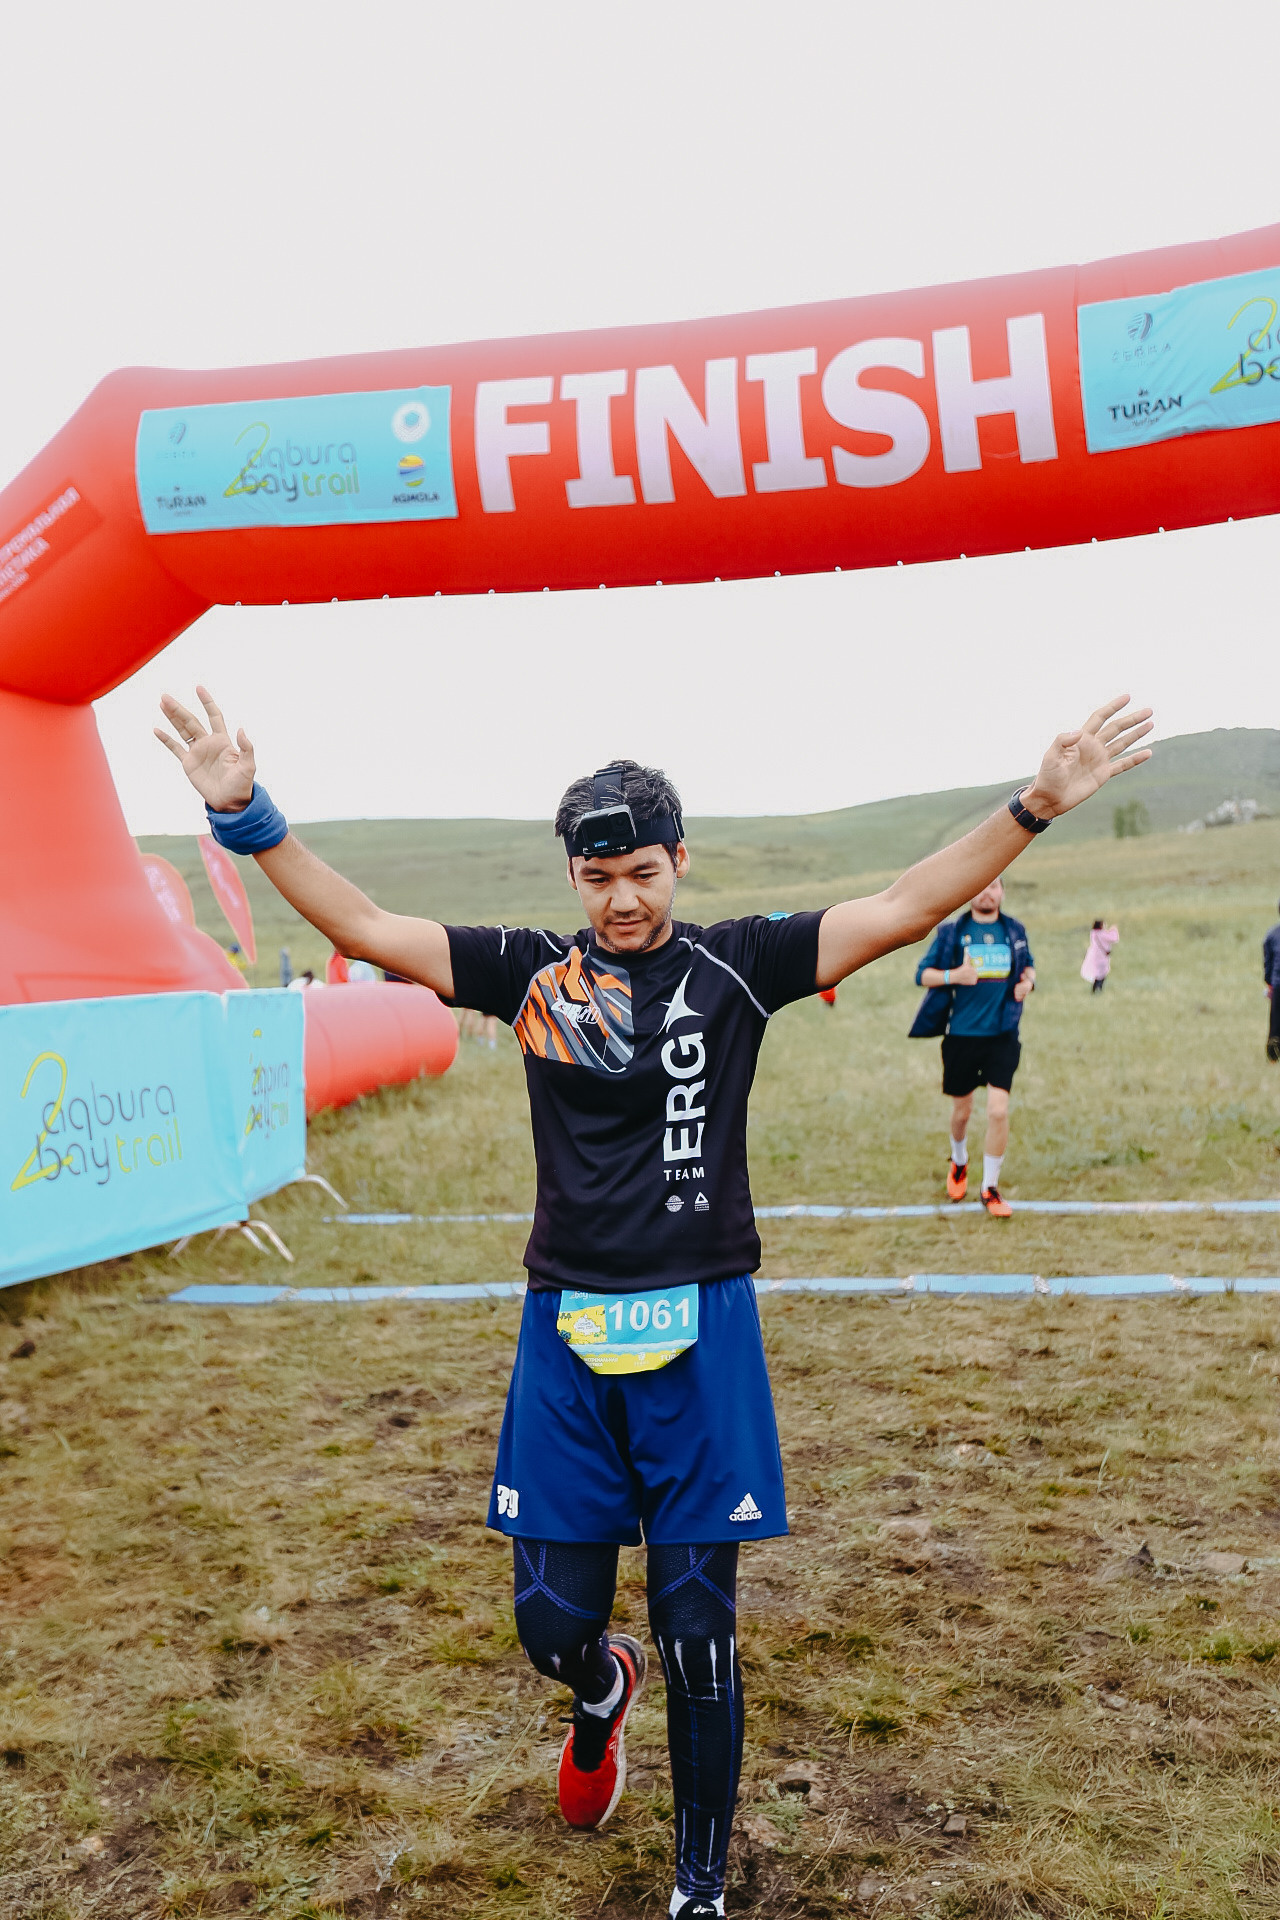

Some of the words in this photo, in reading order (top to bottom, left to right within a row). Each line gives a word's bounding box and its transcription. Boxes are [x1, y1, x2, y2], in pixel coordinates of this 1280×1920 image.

[473, 312, 1059, 514] FINISH
[1108, 395, 1184, 421] TURAN
[42, 1080, 176, 1141] aqbura
[660, 1032, 706, 1162] ERG
[663, 1166, 706, 1182] TEAM
[608, 1298, 690, 1332] 1061
[728, 1510, 763, 1522] adidas
